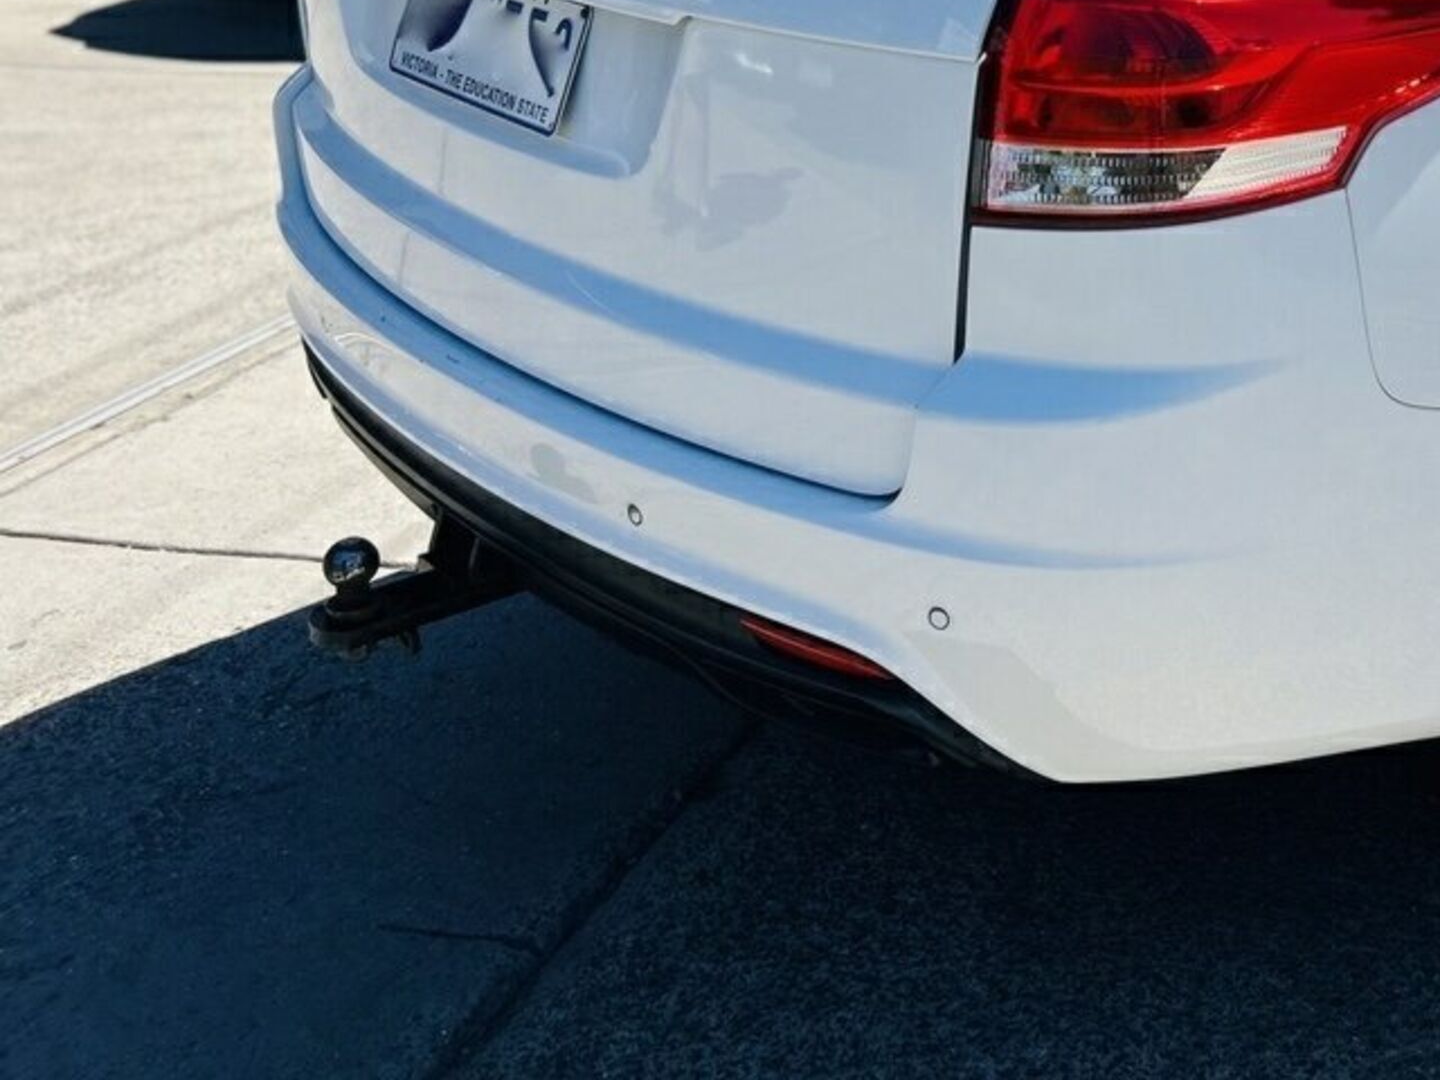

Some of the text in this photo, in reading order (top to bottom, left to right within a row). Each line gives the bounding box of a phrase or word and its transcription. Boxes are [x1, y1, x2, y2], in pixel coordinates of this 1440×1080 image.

[401, 51, 439, 80] VICTORIA
[445, 69, 461, 90] THE
[462, 75, 514, 111] EDUCATION
[516, 98, 549, 124] STATE
